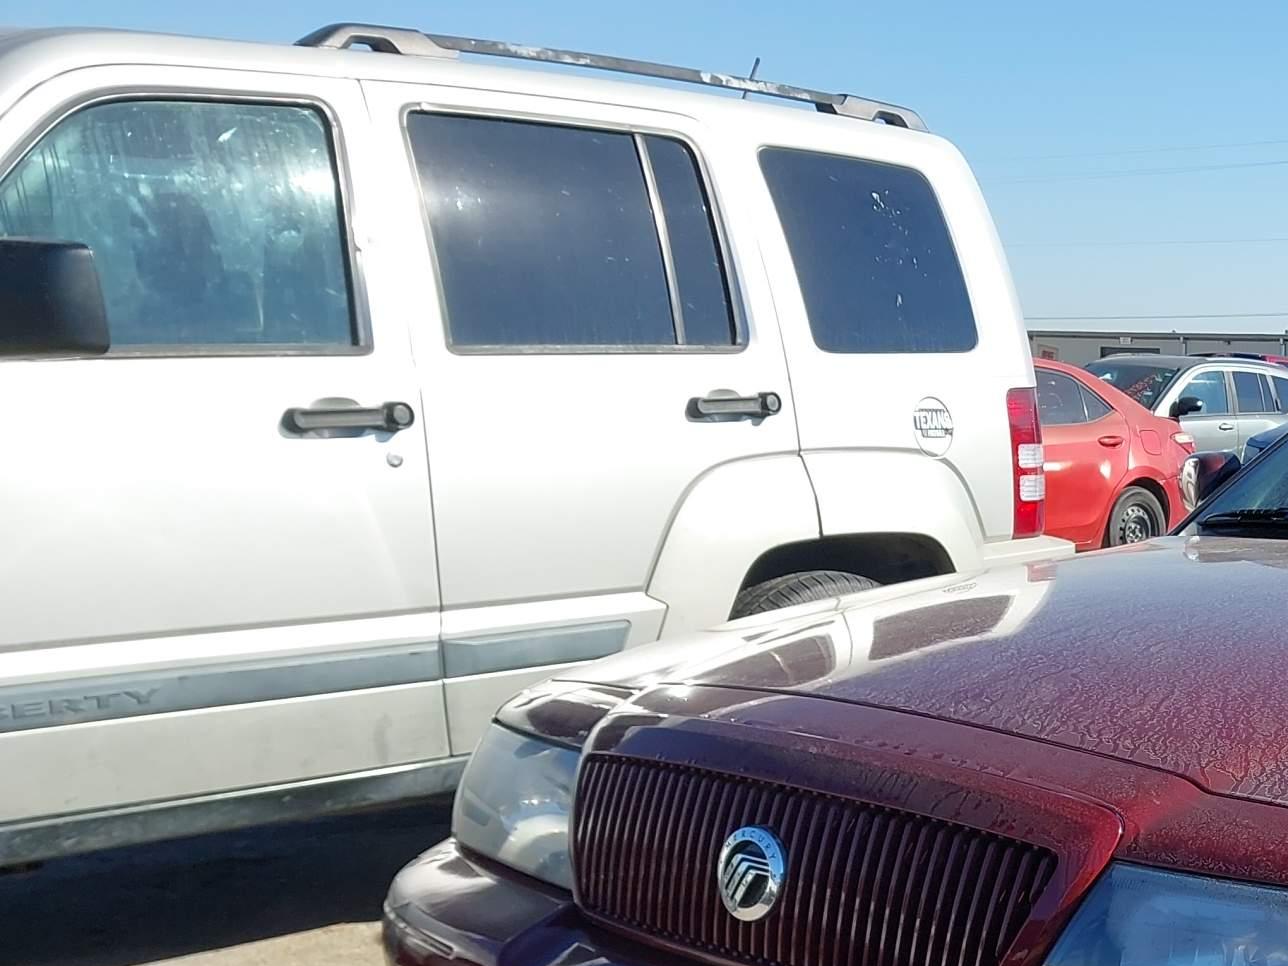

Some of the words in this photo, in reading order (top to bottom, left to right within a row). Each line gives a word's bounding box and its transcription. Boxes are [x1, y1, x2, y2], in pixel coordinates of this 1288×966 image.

[913, 409, 953, 430] TEXANS
[0, 688, 160, 720] ERTY
[725, 830, 777, 858] MERCURY
